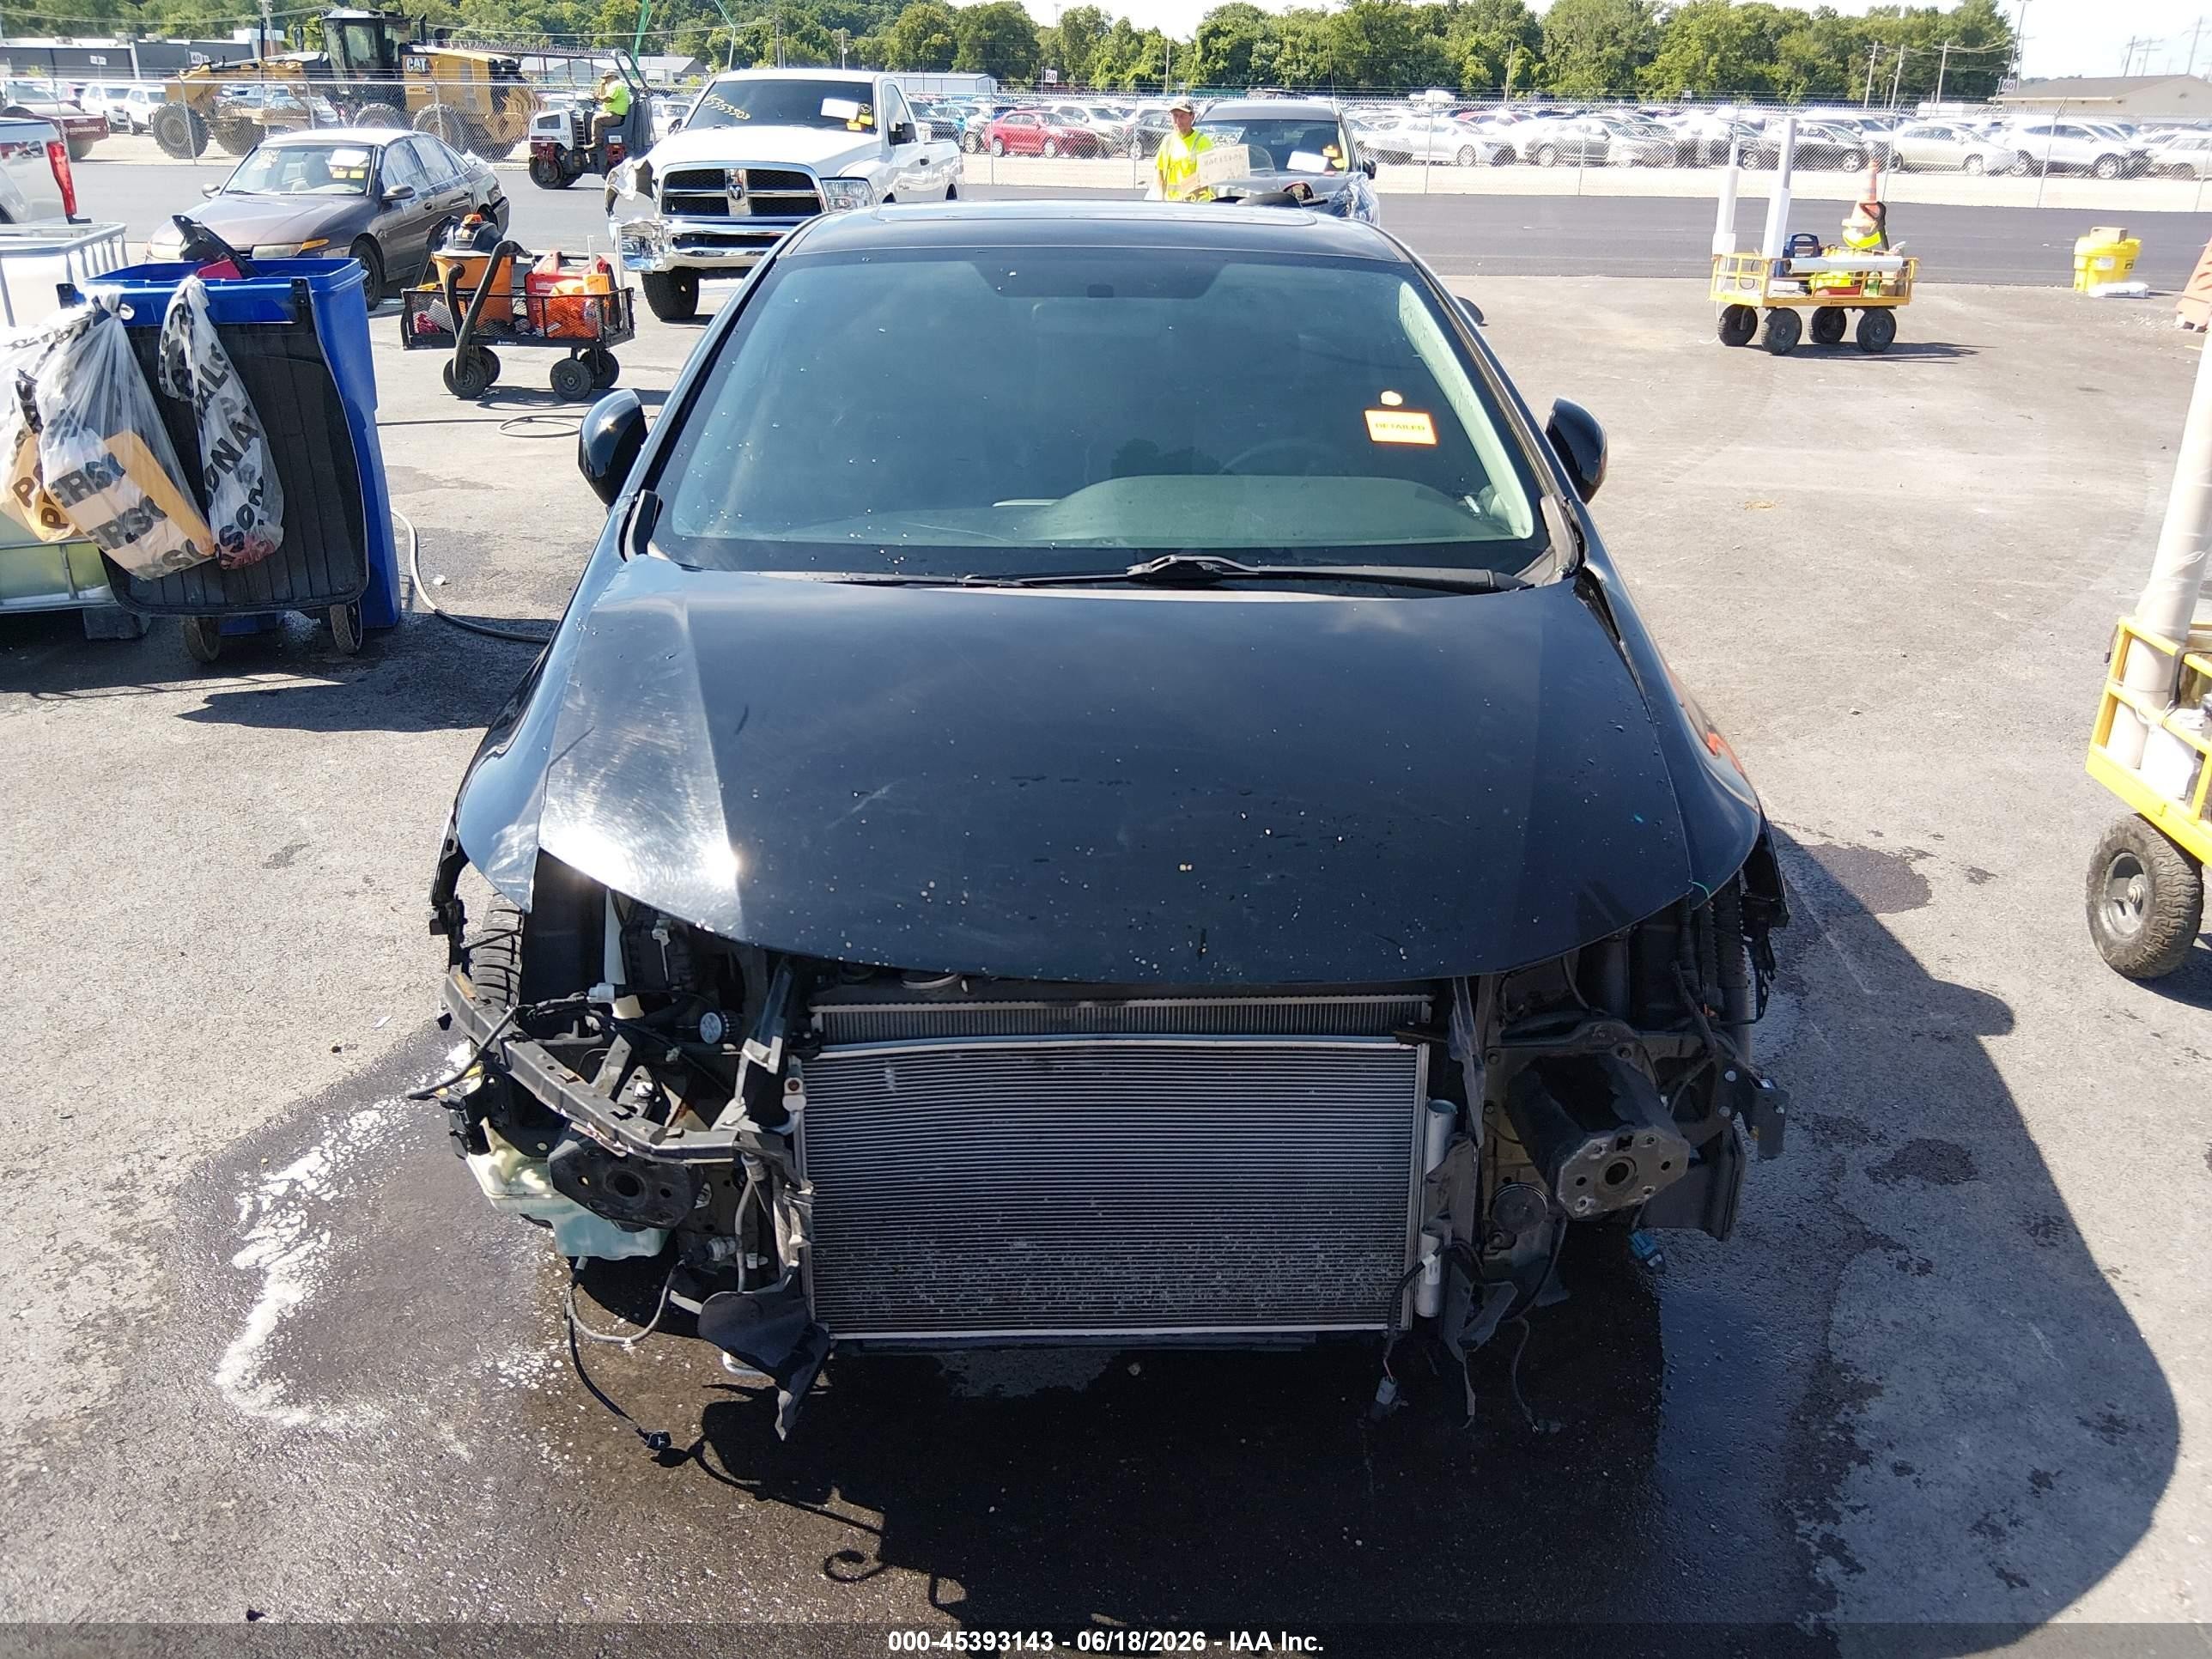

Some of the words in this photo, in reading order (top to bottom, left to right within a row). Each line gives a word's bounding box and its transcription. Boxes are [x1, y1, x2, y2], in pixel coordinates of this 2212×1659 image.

[406, 58, 427, 73] CAT
[1046, 72, 1056, 81] 50
[2002, 82, 2014, 90] 60
